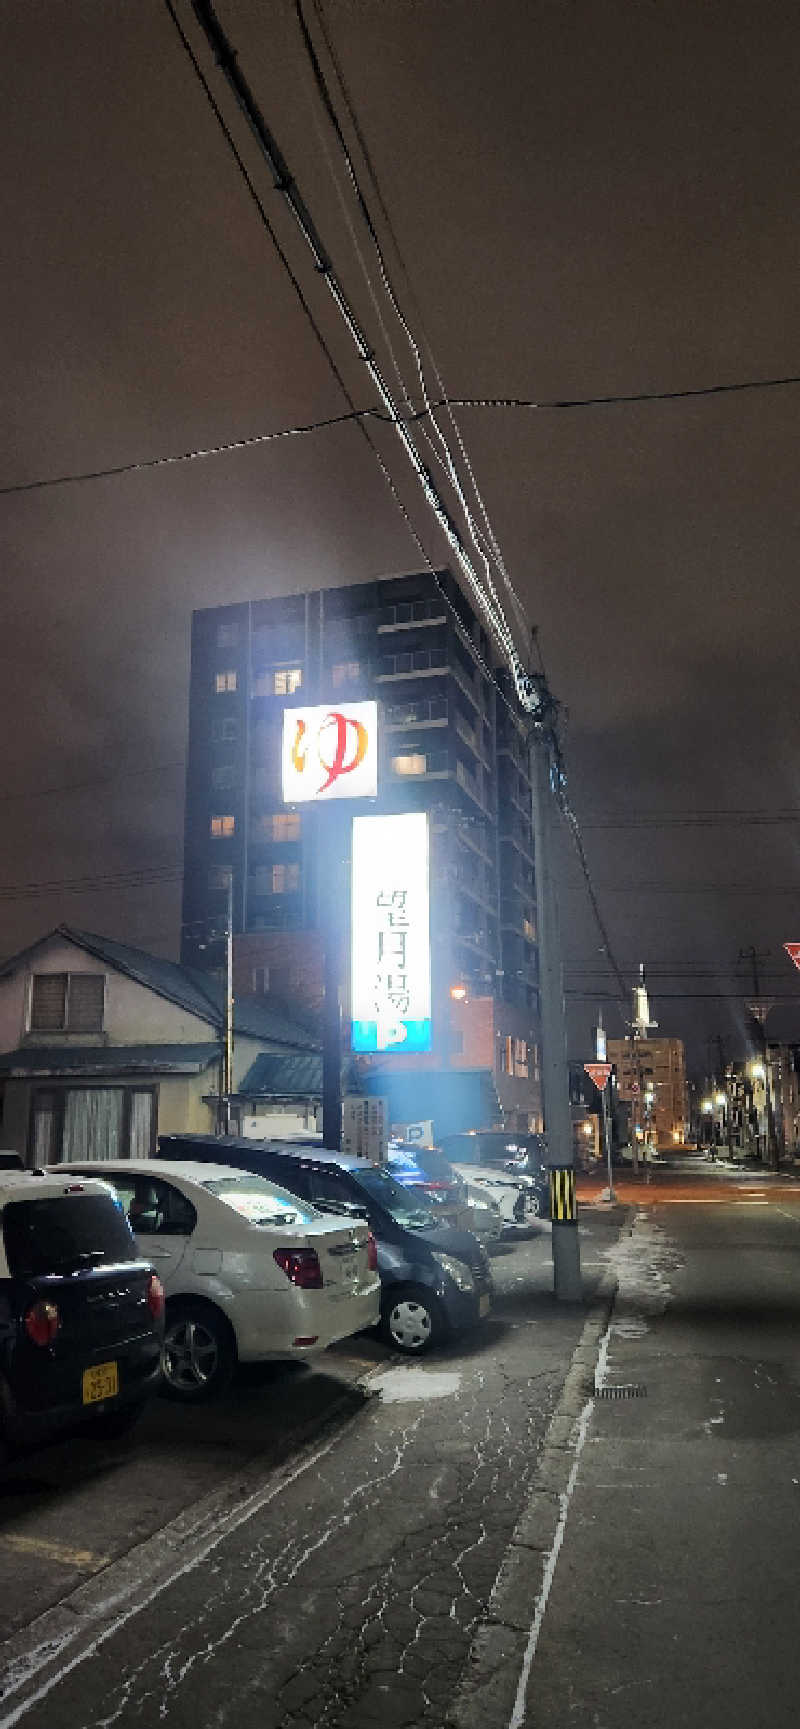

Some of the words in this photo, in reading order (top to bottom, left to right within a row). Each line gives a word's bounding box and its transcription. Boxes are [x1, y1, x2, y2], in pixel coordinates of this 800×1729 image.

[292, 712, 369, 795] ゆ
[374, 890, 411, 1015] 望月湯
[376, 1020, 408, 1050] P
